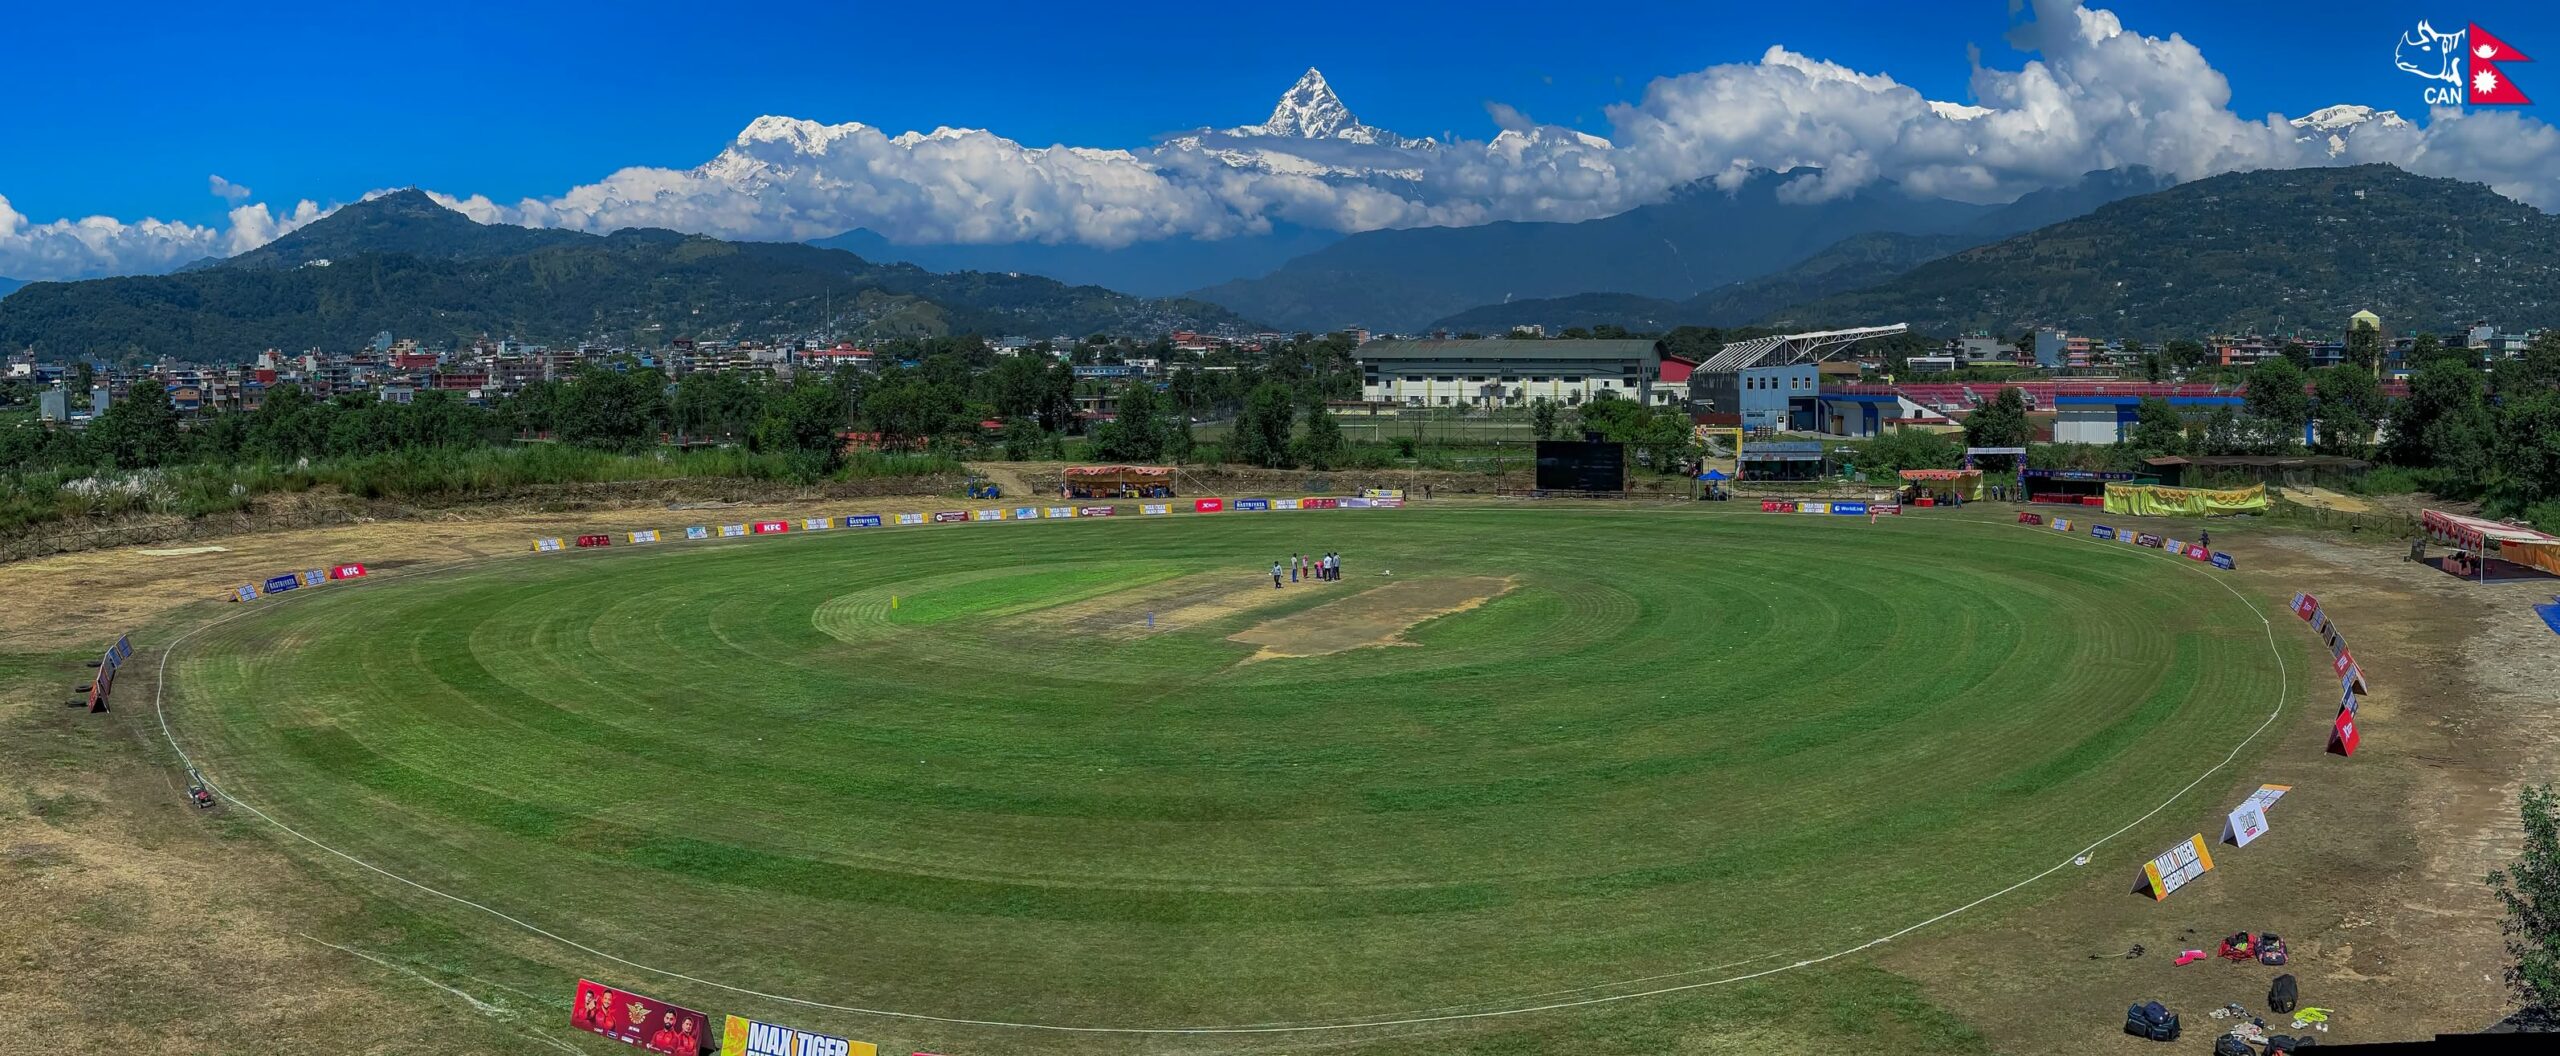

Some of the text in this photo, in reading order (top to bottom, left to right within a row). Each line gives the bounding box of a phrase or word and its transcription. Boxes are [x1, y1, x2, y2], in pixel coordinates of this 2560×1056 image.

[342, 566, 359, 577] KFC
[2155, 841, 2199, 878] MAX TIGER
[2162, 869, 2187, 893] ENERGY
[748, 1022, 848, 1056] MAX TIGER
